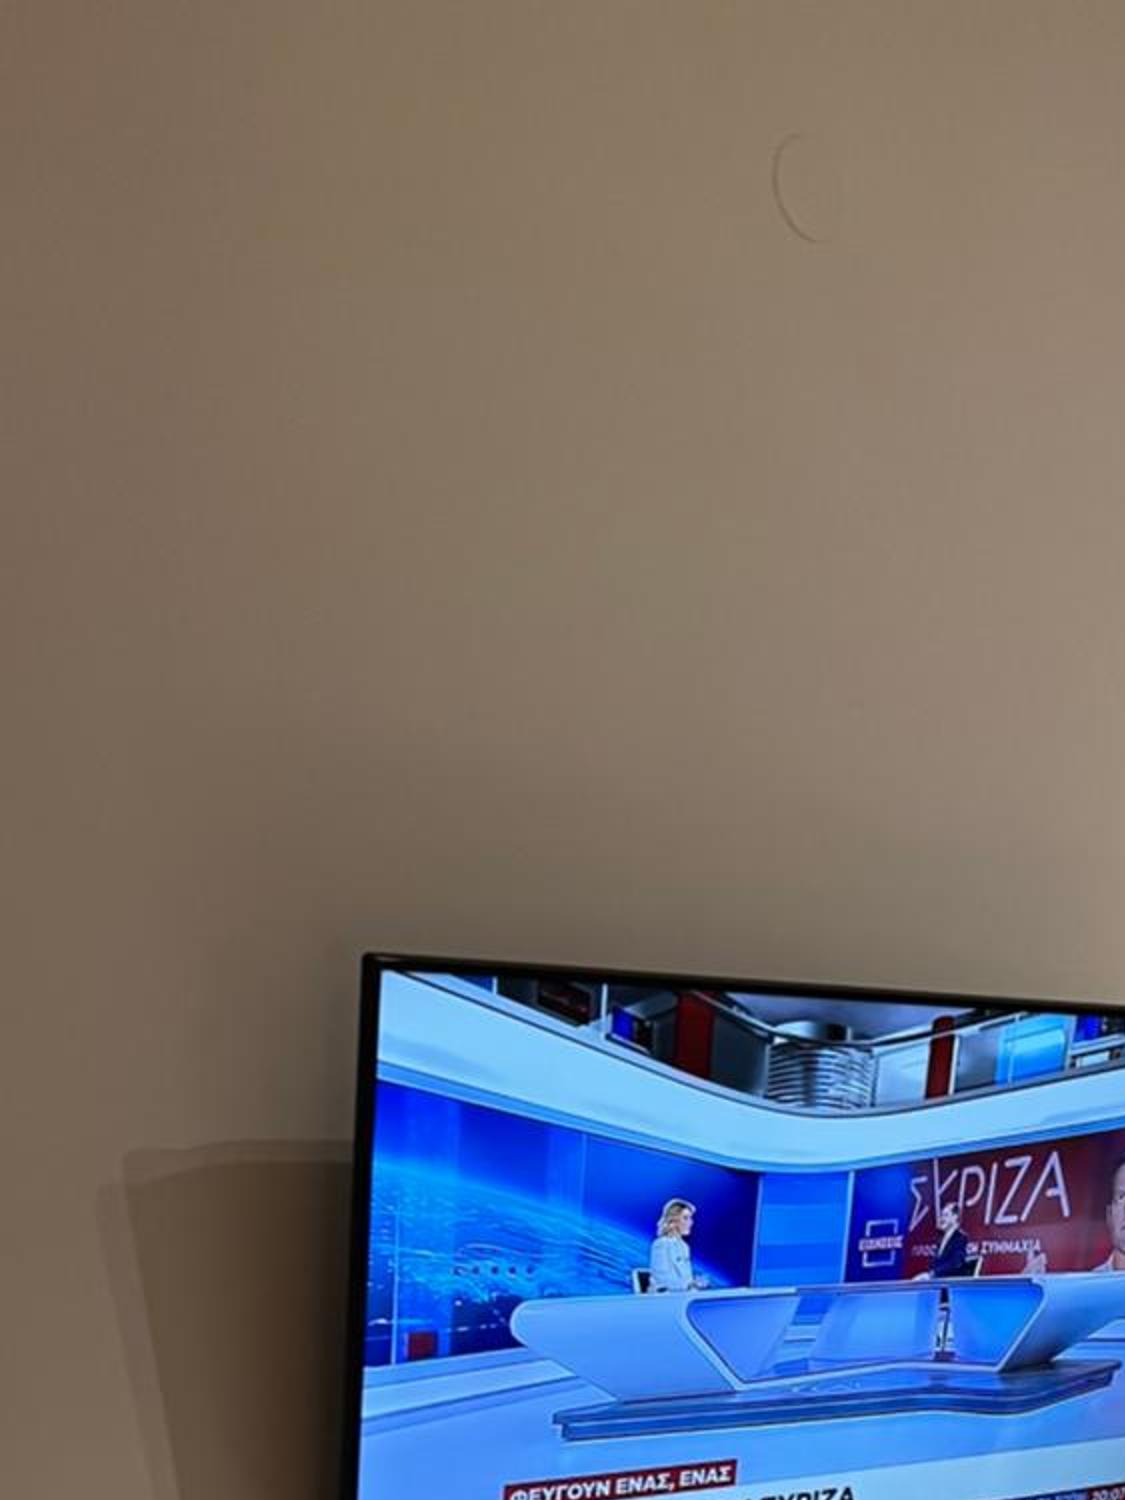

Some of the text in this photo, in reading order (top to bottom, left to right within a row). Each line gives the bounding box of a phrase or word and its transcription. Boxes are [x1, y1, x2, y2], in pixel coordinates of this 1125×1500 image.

[909, 1150, 1072, 1233] ΣΥΡΙΖΑ
[615, 1472, 676, 1495] ΕΝΑΣ,
[679, 1465, 733, 1487] ΕΝΑΣ
